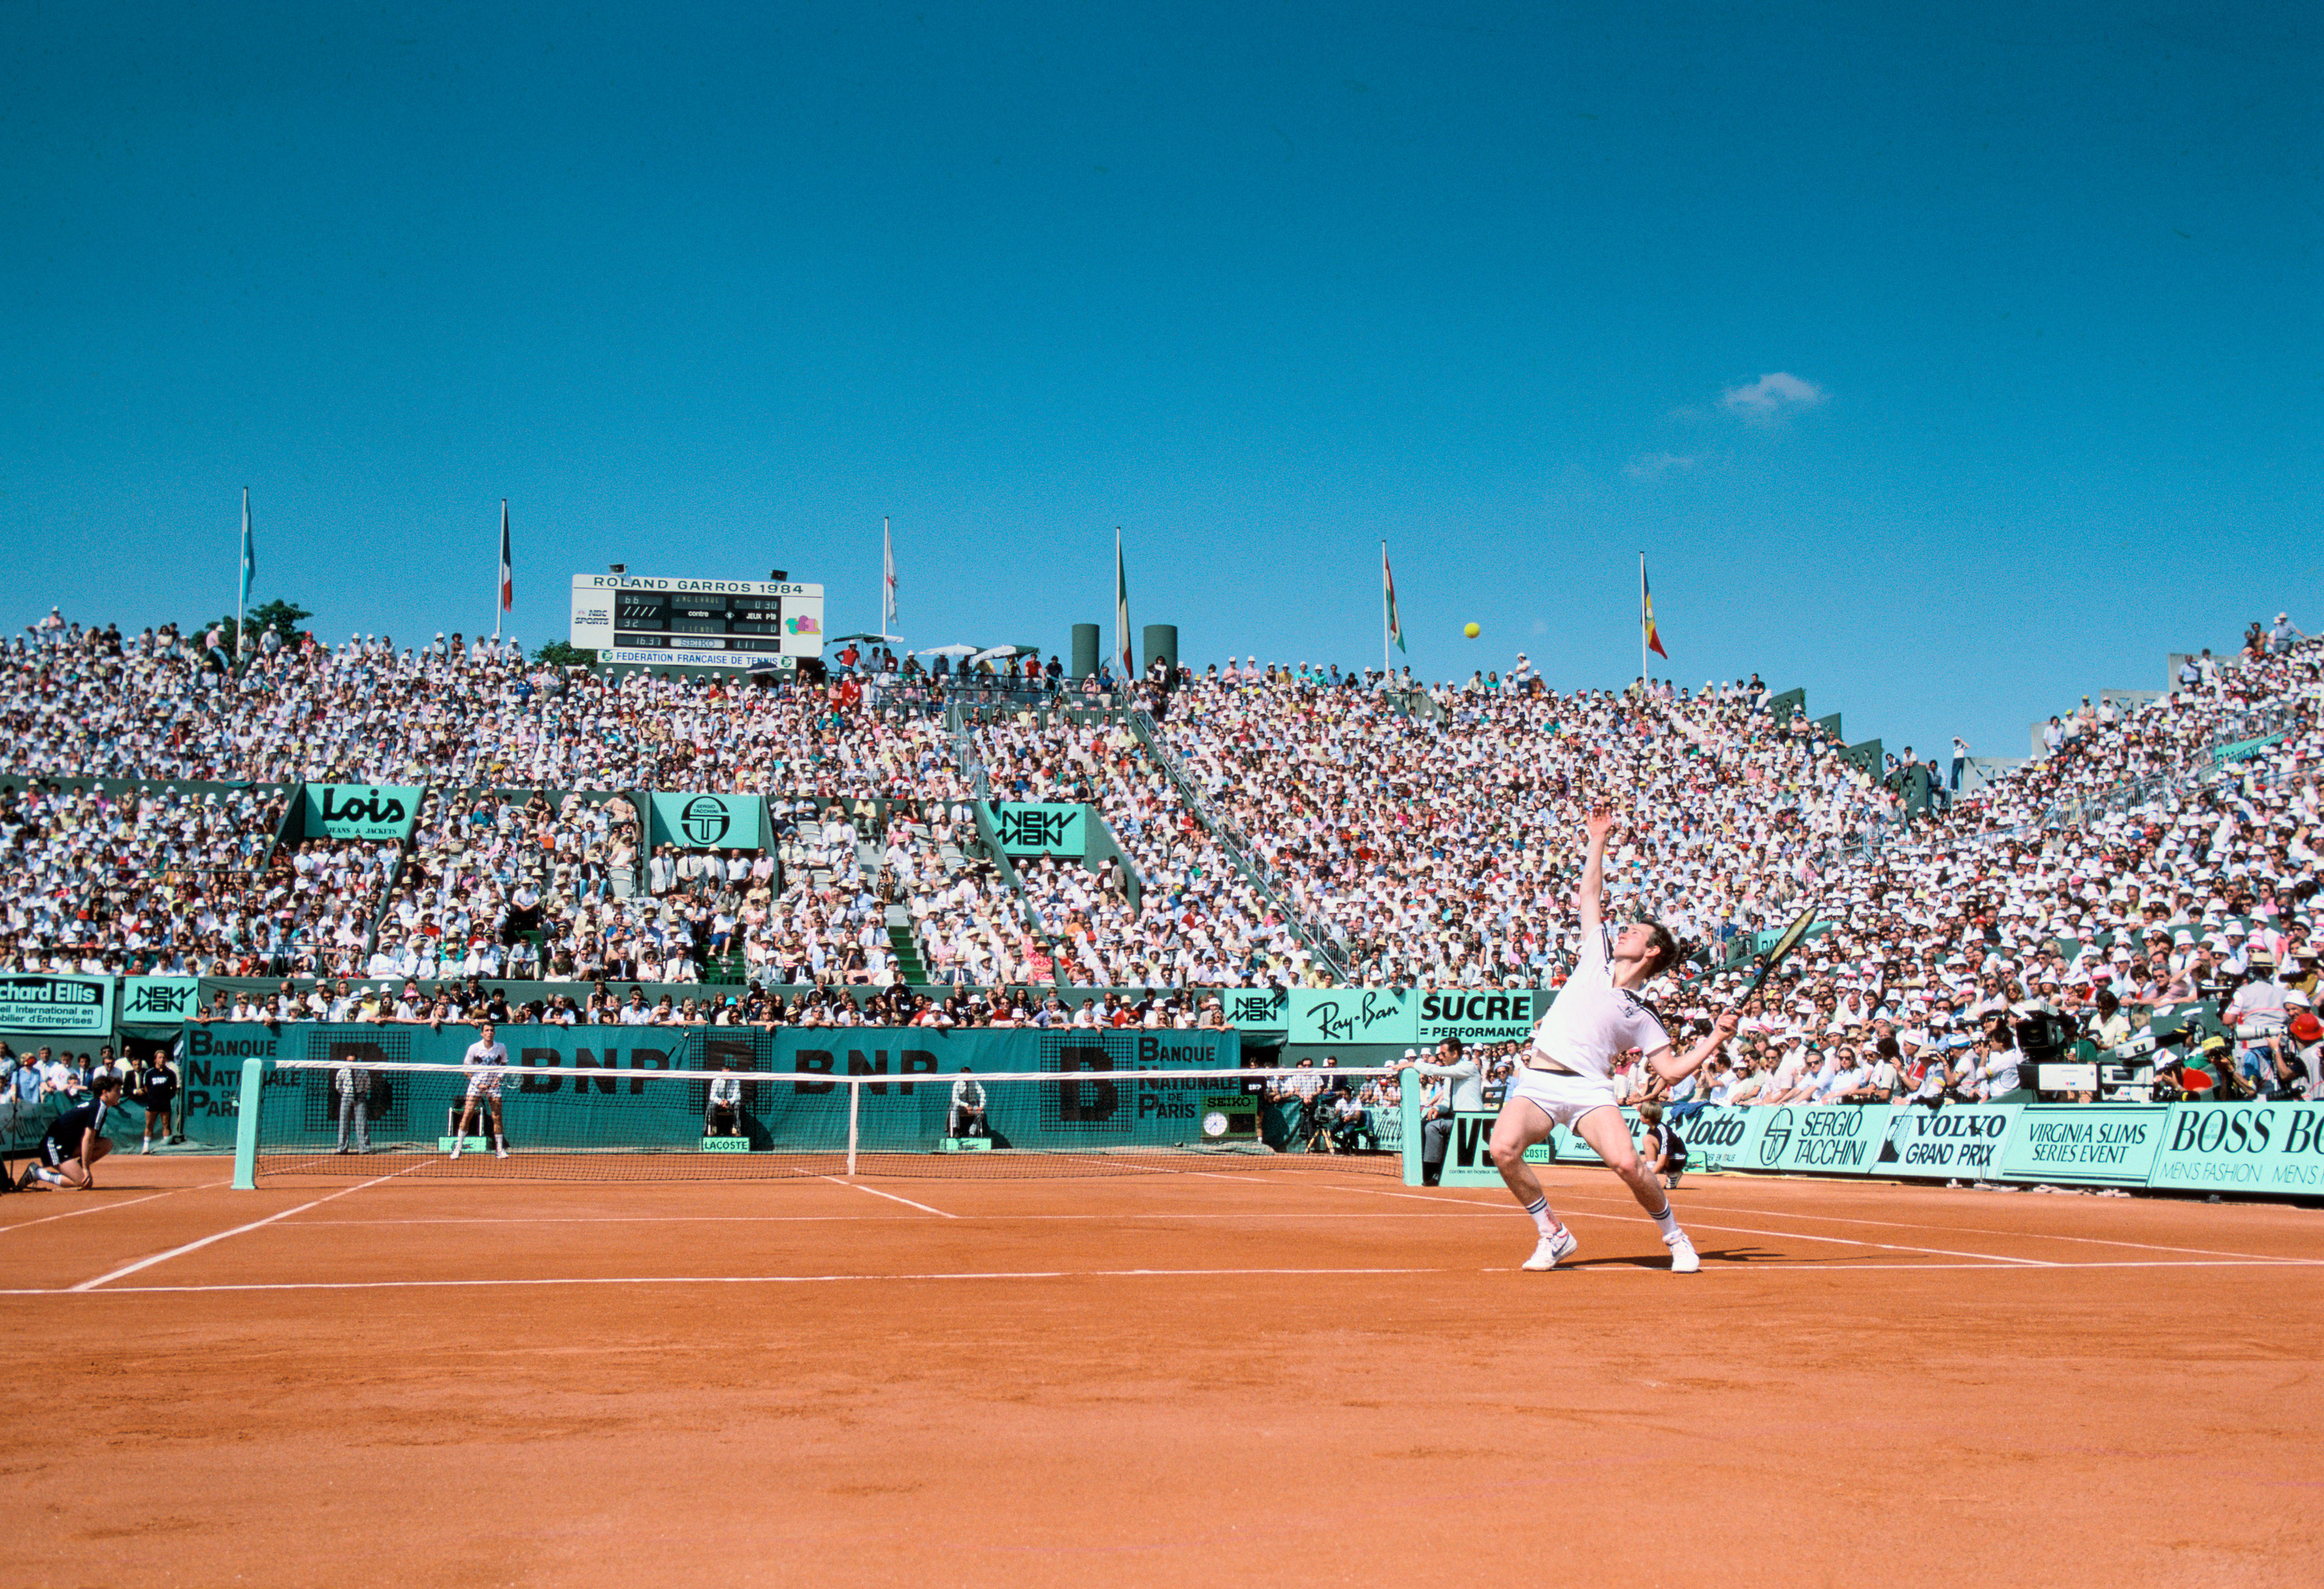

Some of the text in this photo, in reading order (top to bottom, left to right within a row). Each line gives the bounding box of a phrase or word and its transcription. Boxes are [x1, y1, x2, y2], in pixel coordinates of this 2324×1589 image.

[593, 576, 803, 594] ROLAND GARROS 1984
[575, 617, 610, 625] SPORTS
[680, 638, 716, 648] SEIKO
[616, 652, 673, 662] FEDERATION
[731, 655, 744, 665] DE
[746, 656, 779, 666] TENNIS
[321, 787, 405, 823] Lois
[54, 982, 96, 1003] Ellis
[0, 1013, 93, 1026] bilier d'Entreprises
[15, 1005, 77, 1016] International
[1306, 991, 1399, 1040] Ray-Ban
[1421, 996, 1532, 1022] SUCRE
[1432, 1027, 1532, 1037] PERFORMANCE
[189, 1030, 277, 1058] BANQUE
[1138, 1037, 1215, 1063] BANQUE
[521, 1047, 670, 1095] BNP
[795, 1049, 939, 1095] BNP
[1138, 1093, 1195, 1119] PARIS
[1207, 1096, 1251, 1108] SEIKO
[1801, 1110, 1863, 1137] SERGIO
[1917, 1115, 2007, 1138] VOLVO
[2030, 1123, 2147, 1144] VIRGINIA SLIMS
[2169, 1109, 2275, 1154] BOSS
[703, 1140, 748, 1150] LACOSTE
[1793, 1139, 1868, 1165] TACCHINI
[1906, 1143, 1996, 1166] GRAND PRIX
[2032, 1144, 2130, 1164] SERIES EVENT
[2159, 1162, 2319, 1185] MEN'S FASHION MEN'S
